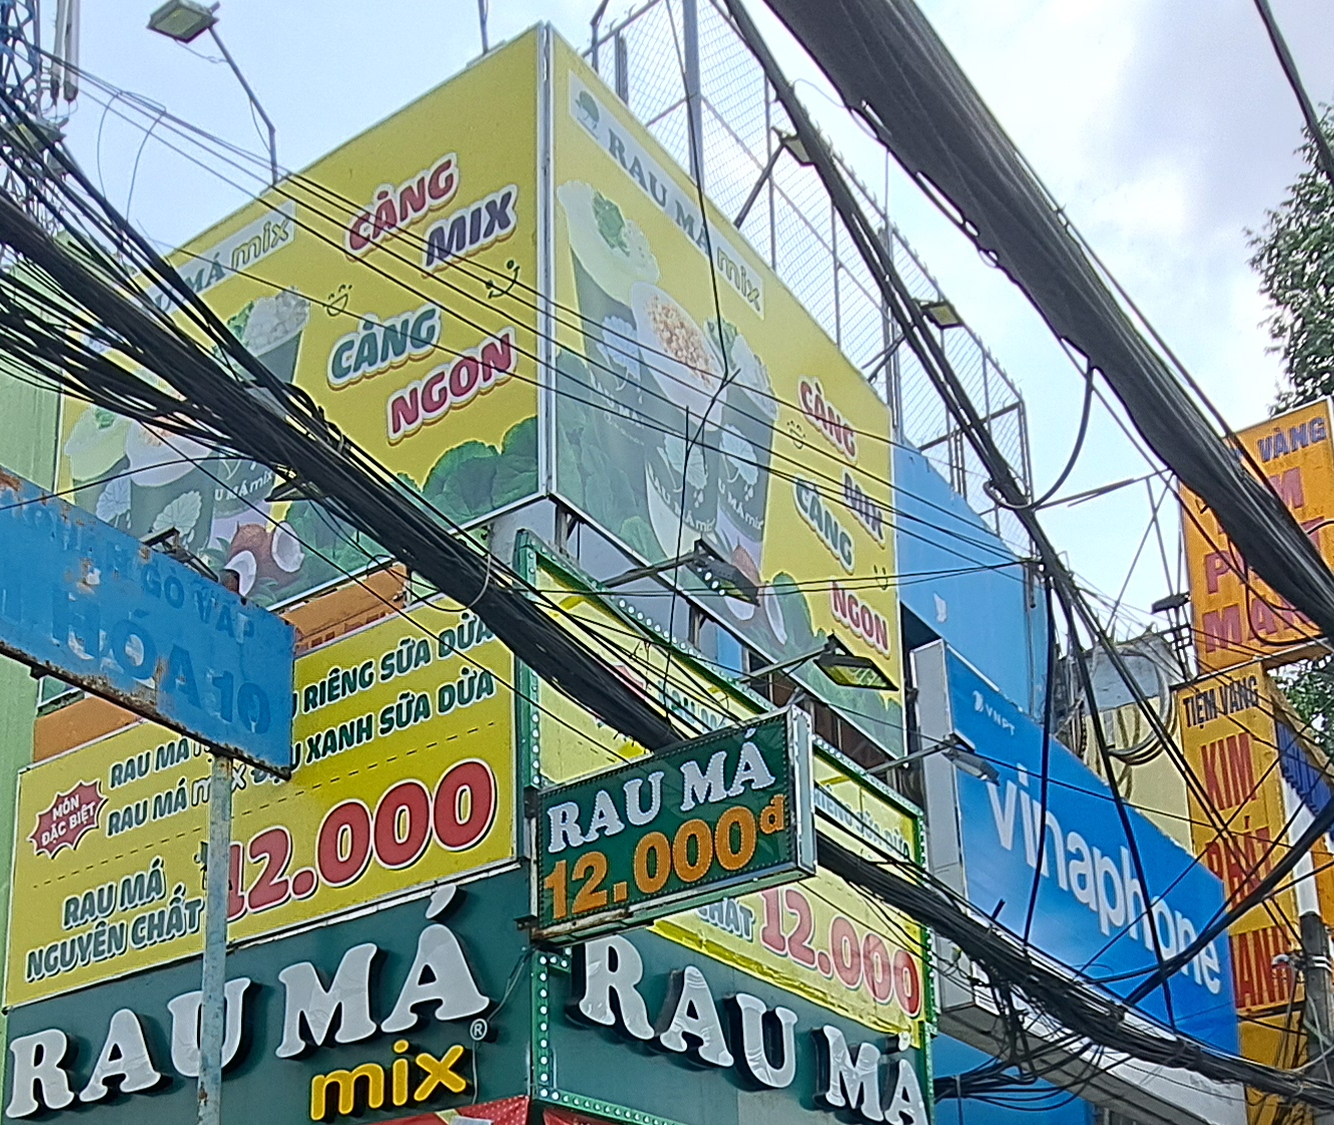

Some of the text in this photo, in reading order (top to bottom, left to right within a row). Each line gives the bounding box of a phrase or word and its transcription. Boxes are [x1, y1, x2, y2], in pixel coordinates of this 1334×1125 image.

[231, 214, 290, 268] mix
[346, 153, 458, 252] CÀNG
[424, 192, 516, 267] MIX
[608, 127, 668, 207] RAU
[717, 246, 762, 313] mix
[331, 306, 440, 380] CÀNG
[388, 328, 516, 440] NGON
[303, 663, 374, 714] RIÊNG
[380, 636, 431, 680] SỮA
[305, 665, 495, 762] XANH SỮA DỪA
[985, 705, 1016, 737] VNPT
[52, 795, 81, 819] MÓN
[107, 764, 247, 837] RAU MÁ mx
[109, 754, 151, 789] RAU
[547, 768, 665, 854] RAU
[678, 726, 777, 813] MÁ
[1200, 732, 1257, 813] KIM
[41, 803, 98, 848] ĐẶC BIỆT
[228, 760, 499, 920] 12.000
[63, 880, 120, 930] RAU
[119, 857, 165, 908] MÁ
[987, 757, 1222, 996] vinaphone
[27, 885, 204, 979] NGUYÊN CHẤT
[760, 888, 923, 1018] 12.000
[4, 884, 490, 1120] RAU MÁ
[578, 934, 798, 1089] RAU
[310, 1038, 468, 1121] mix
